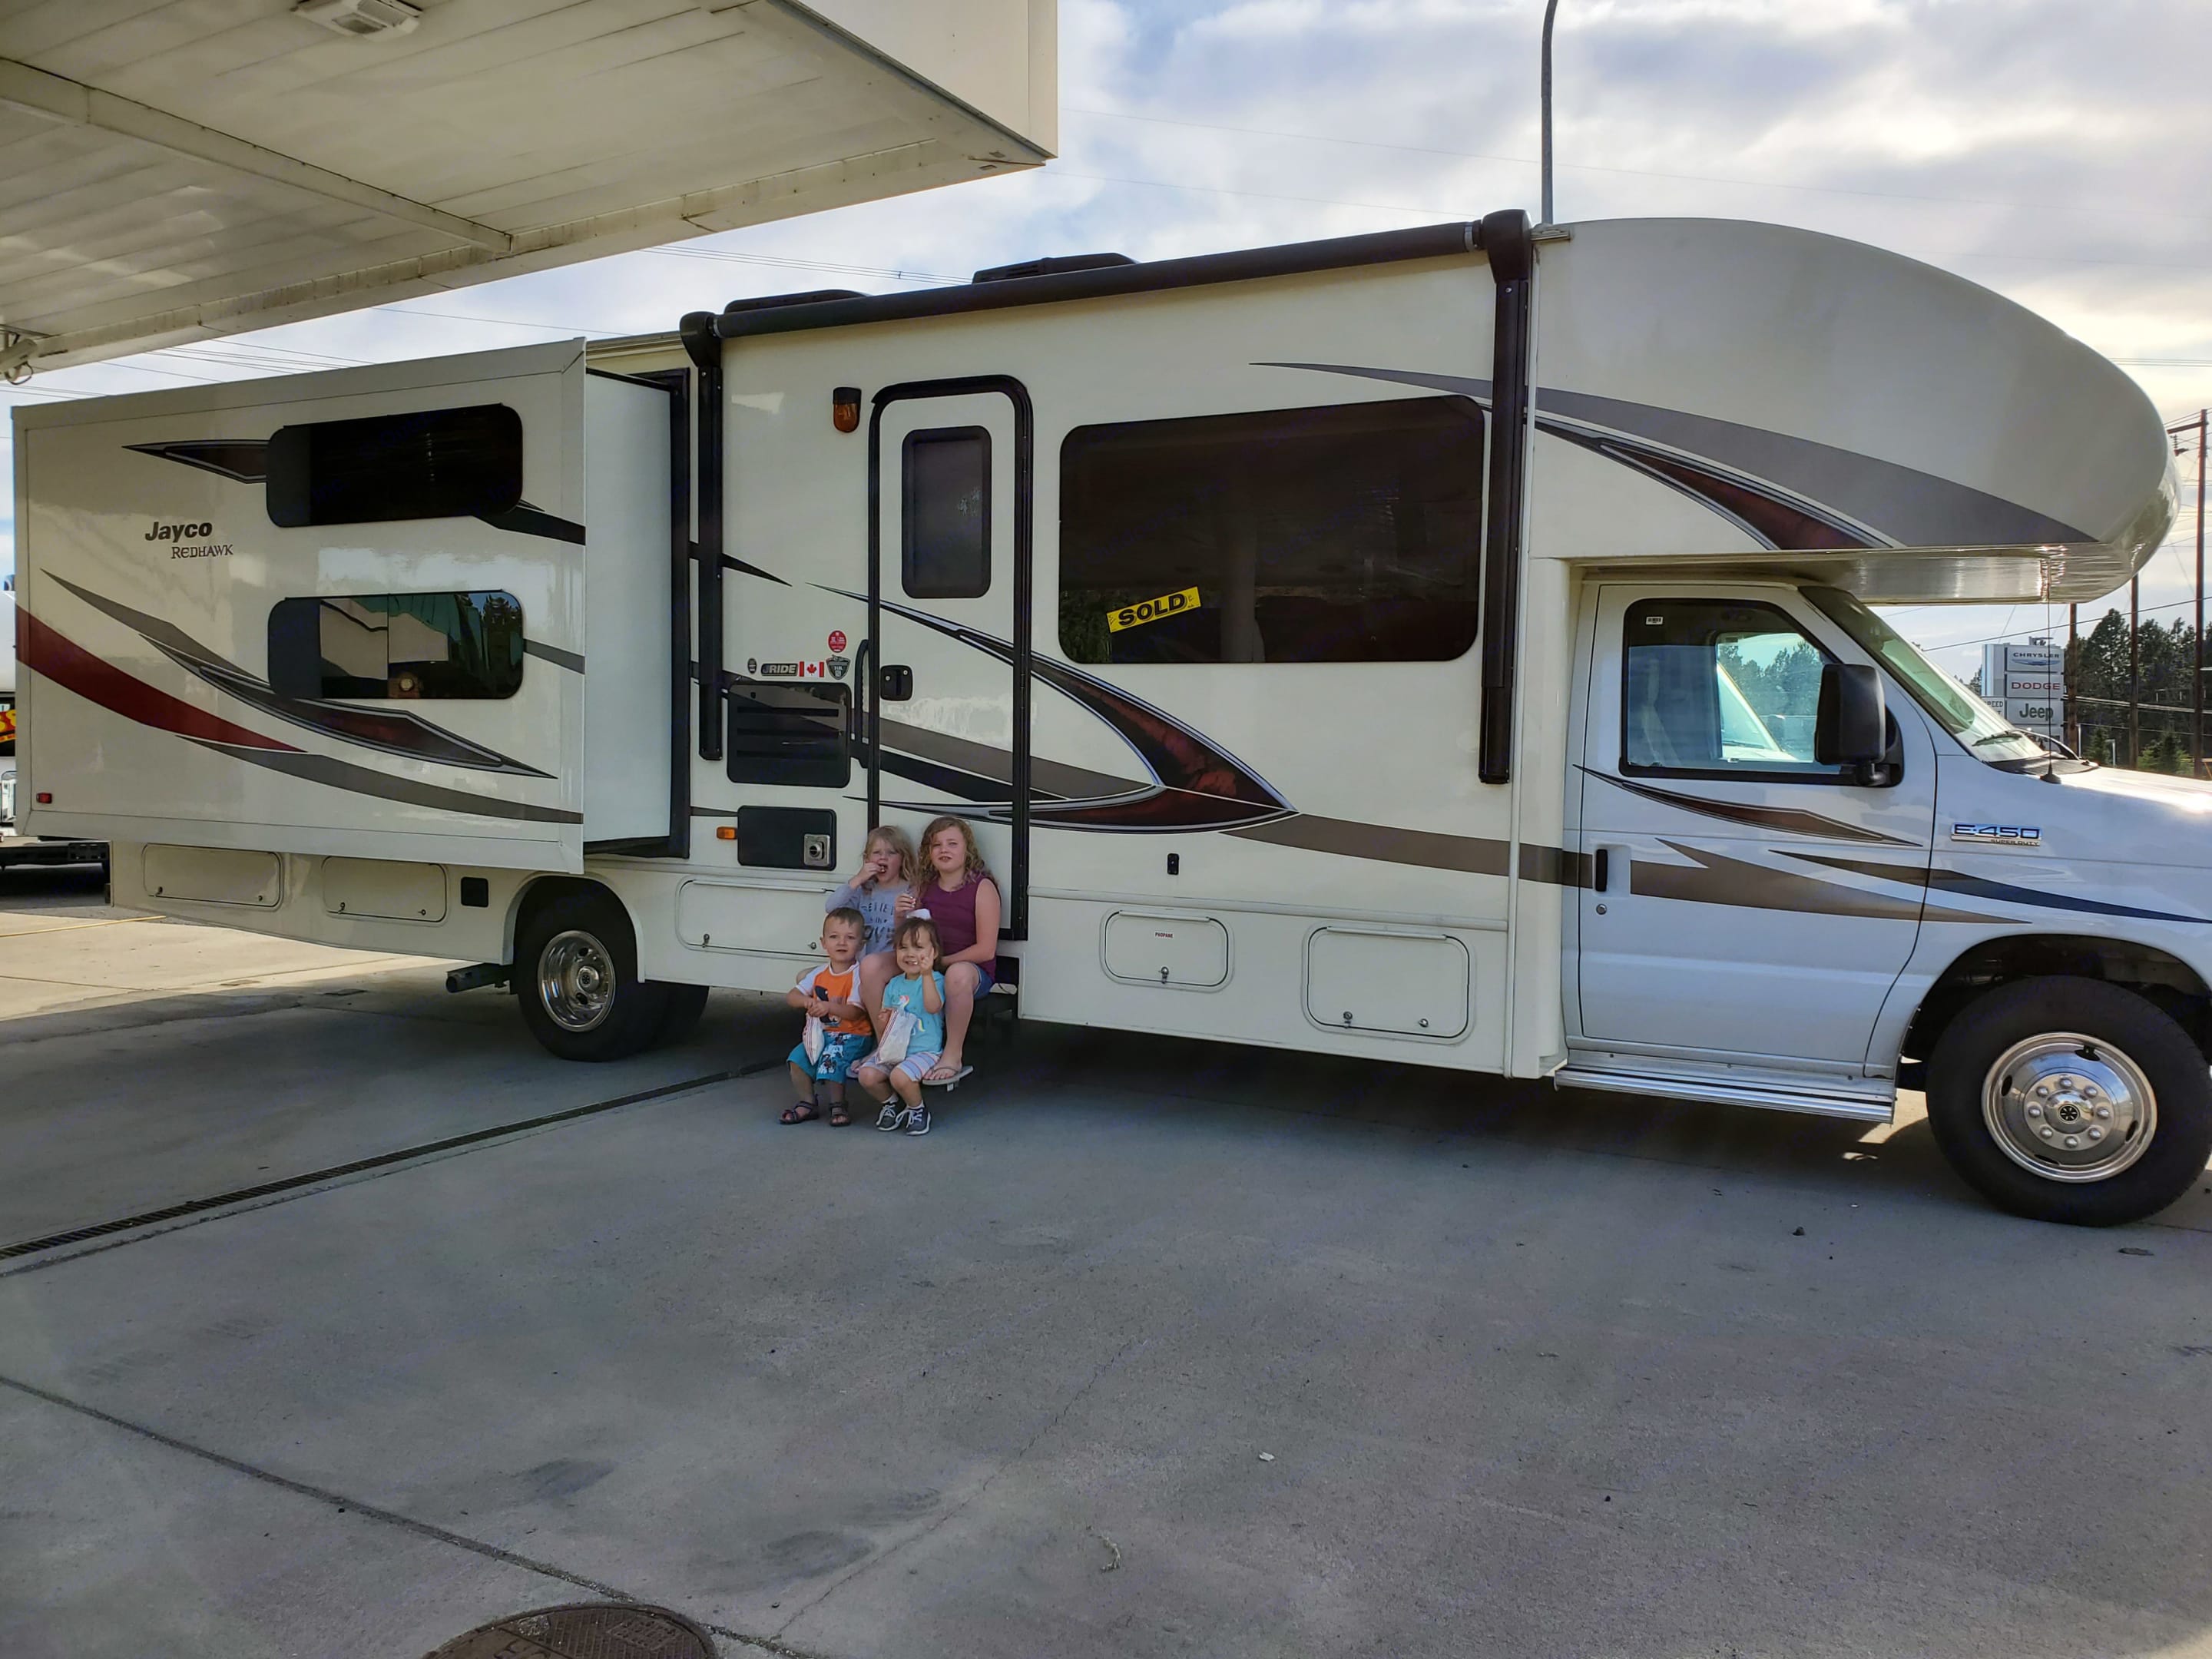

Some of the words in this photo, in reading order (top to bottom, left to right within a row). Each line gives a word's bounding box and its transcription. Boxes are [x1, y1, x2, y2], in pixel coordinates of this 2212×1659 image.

[144, 522, 213, 543] Jayco
[1118, 593, 1187, 627] SOLD
[2011, 681, 2061, 690] DODGE
[2018, 703, 2054, 721] Jeep
